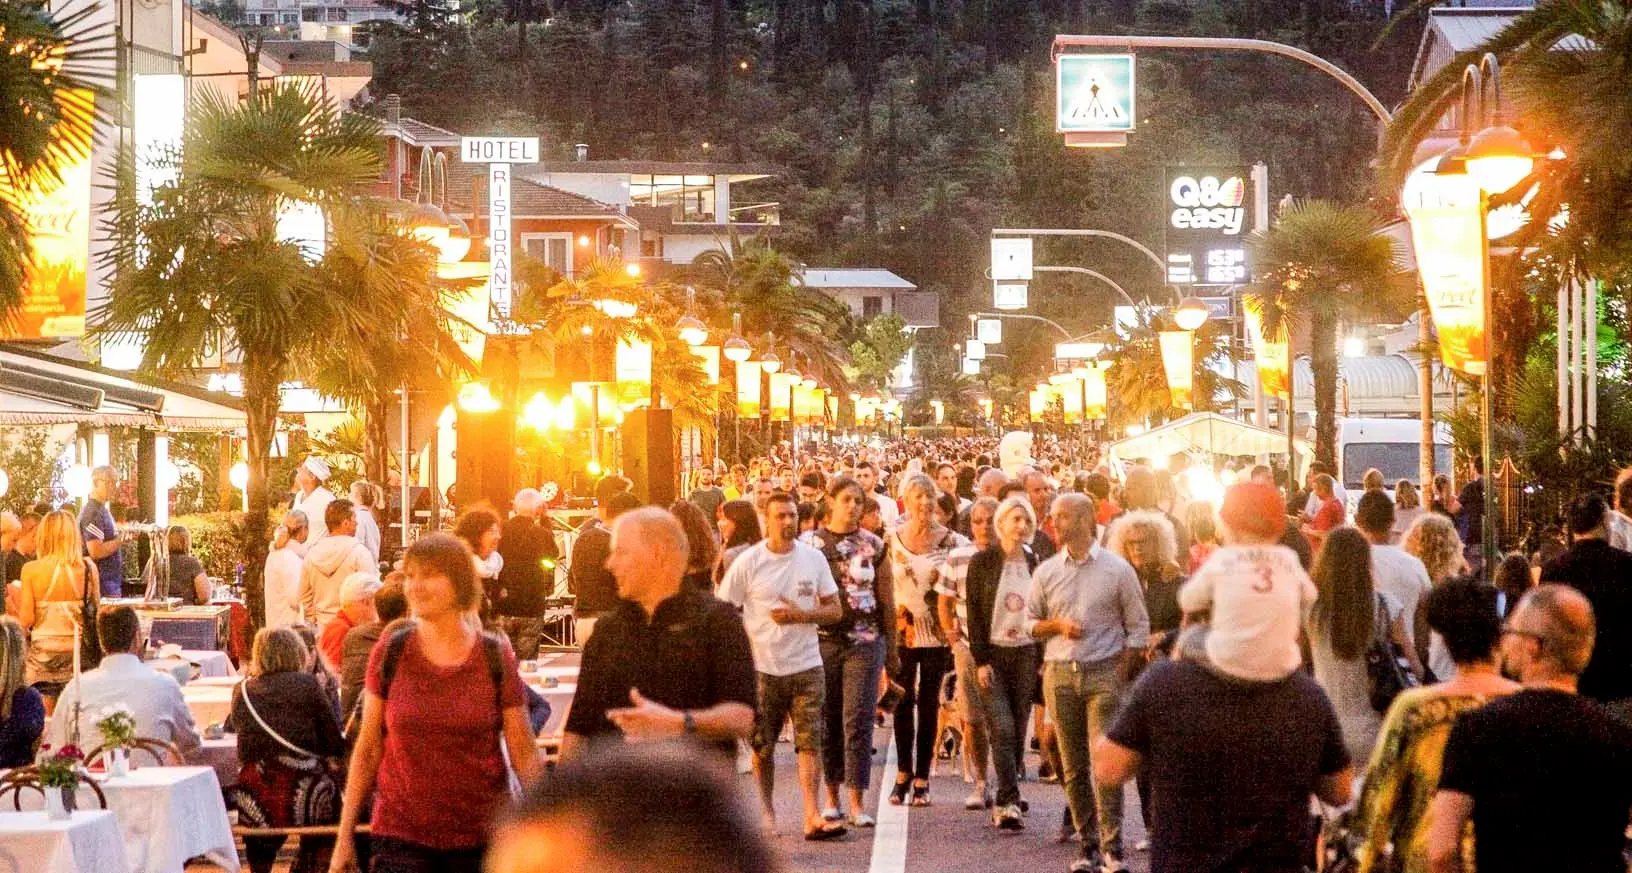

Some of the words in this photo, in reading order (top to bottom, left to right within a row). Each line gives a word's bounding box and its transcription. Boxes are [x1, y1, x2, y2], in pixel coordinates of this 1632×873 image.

[469, 140, 533, 160] HOTEL
[1171, 176, 1221, 207] Q8
[1172, 208, 1244, 235] easy
[1252, 567, 1273, 593] 3
